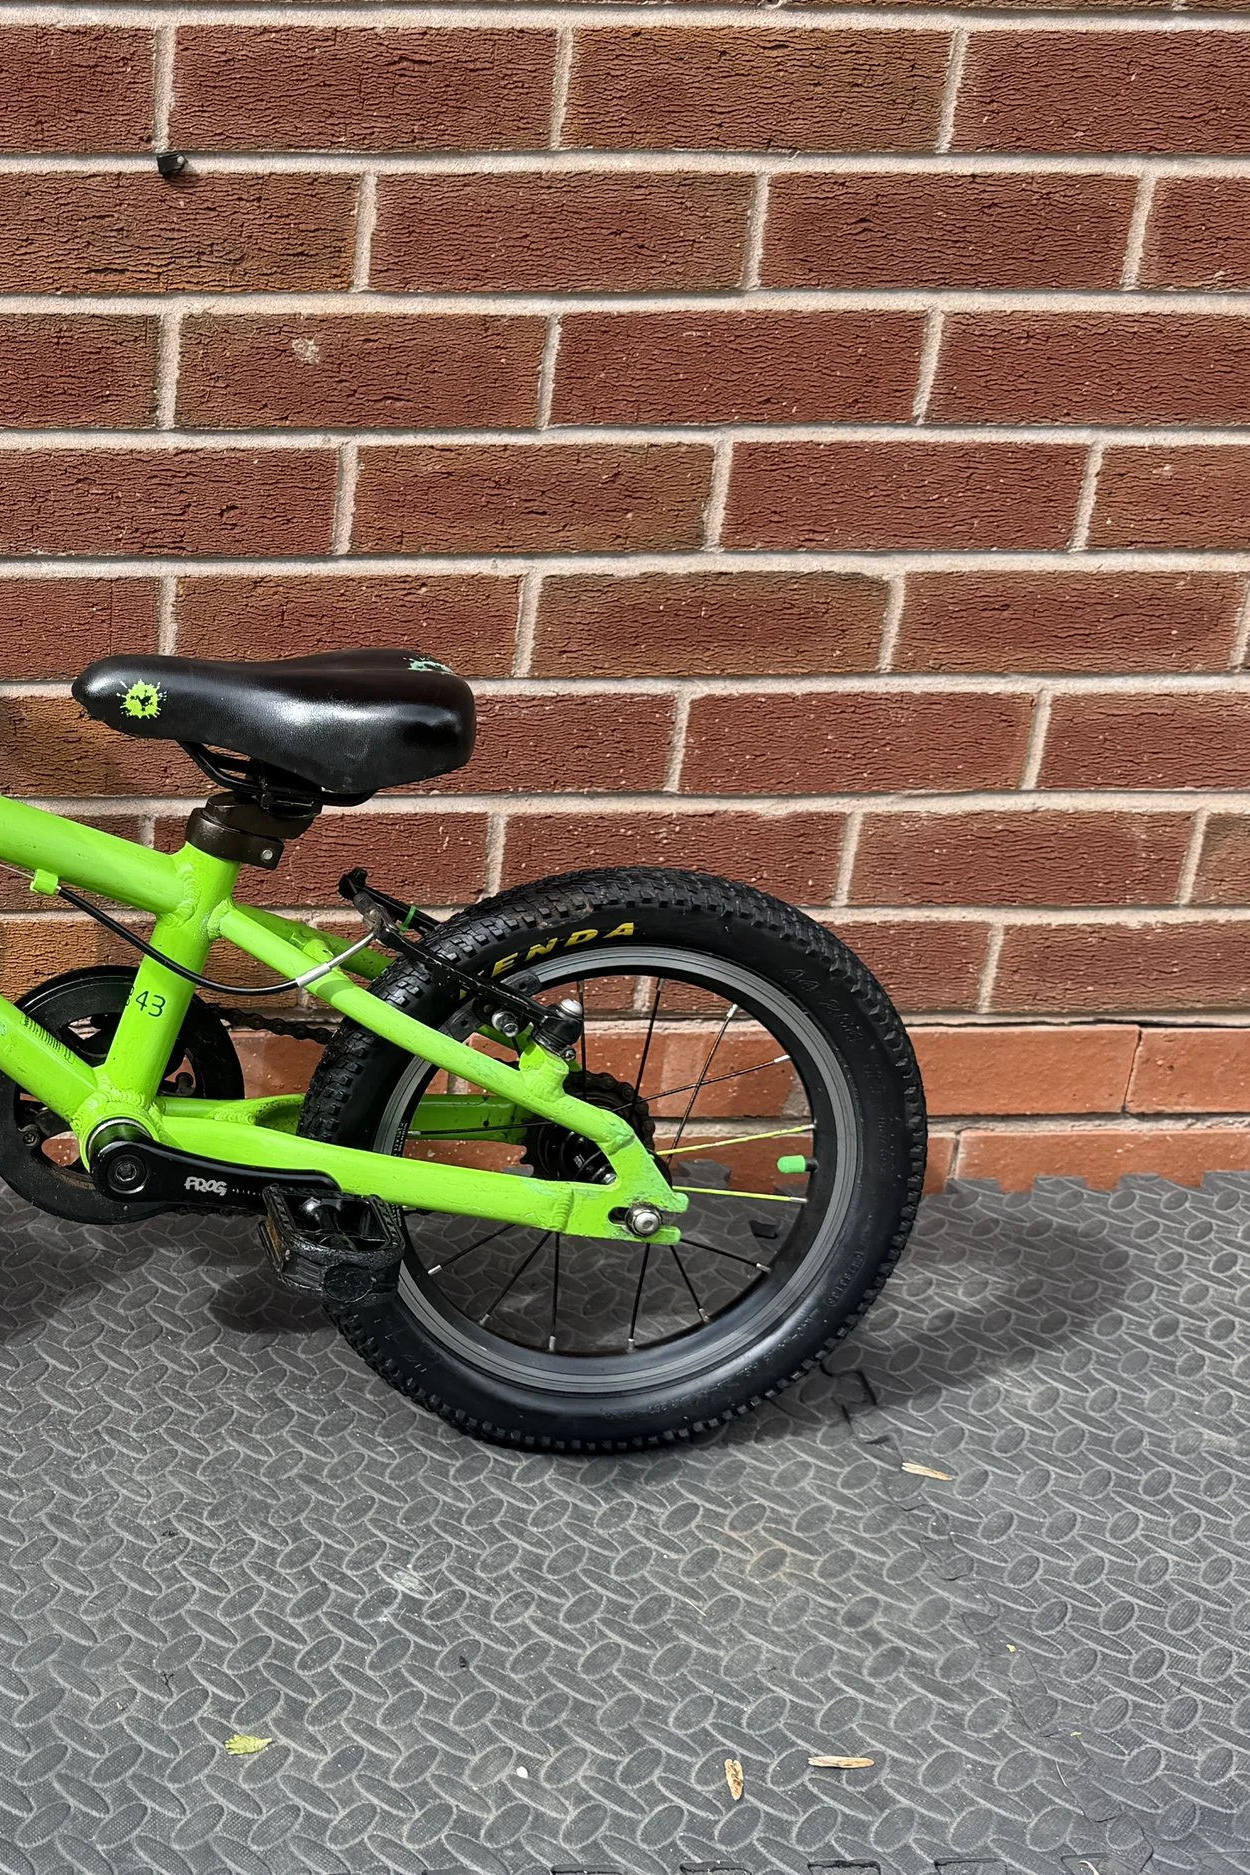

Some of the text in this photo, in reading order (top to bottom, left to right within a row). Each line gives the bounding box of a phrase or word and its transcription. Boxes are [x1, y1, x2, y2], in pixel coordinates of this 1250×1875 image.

[466, 922, 634, 985] ENDA
[135, 990, 166, 1017] 43
[183, 1176, 228, 1196] FROG
